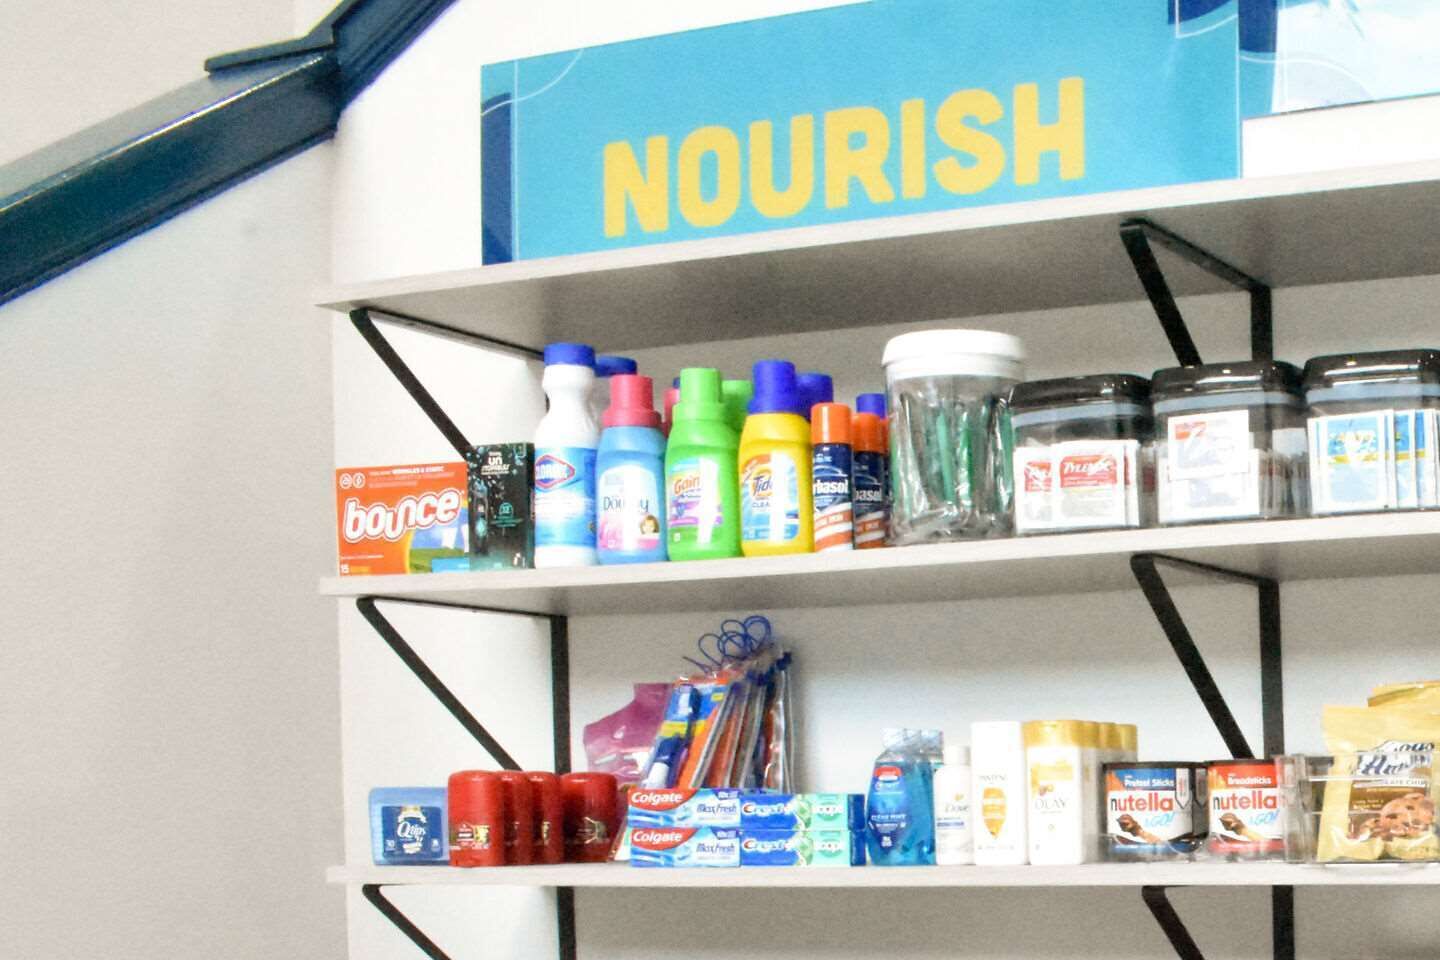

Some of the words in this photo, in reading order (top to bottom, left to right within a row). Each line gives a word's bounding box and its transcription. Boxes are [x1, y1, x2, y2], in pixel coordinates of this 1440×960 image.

[604, 76, 1085, 238] NOURISH
[752, 474, 772, 493] Tid
[814, 479, 848, 494] rbasol
[344, 488, 462, 543] bounce
[631, 791, 683, 806] Colgate
[1111, 792, 1174, 812] nutella
[1213, 790, 1277, 811] nutella
[633, 829, 683, 845] Colgate
